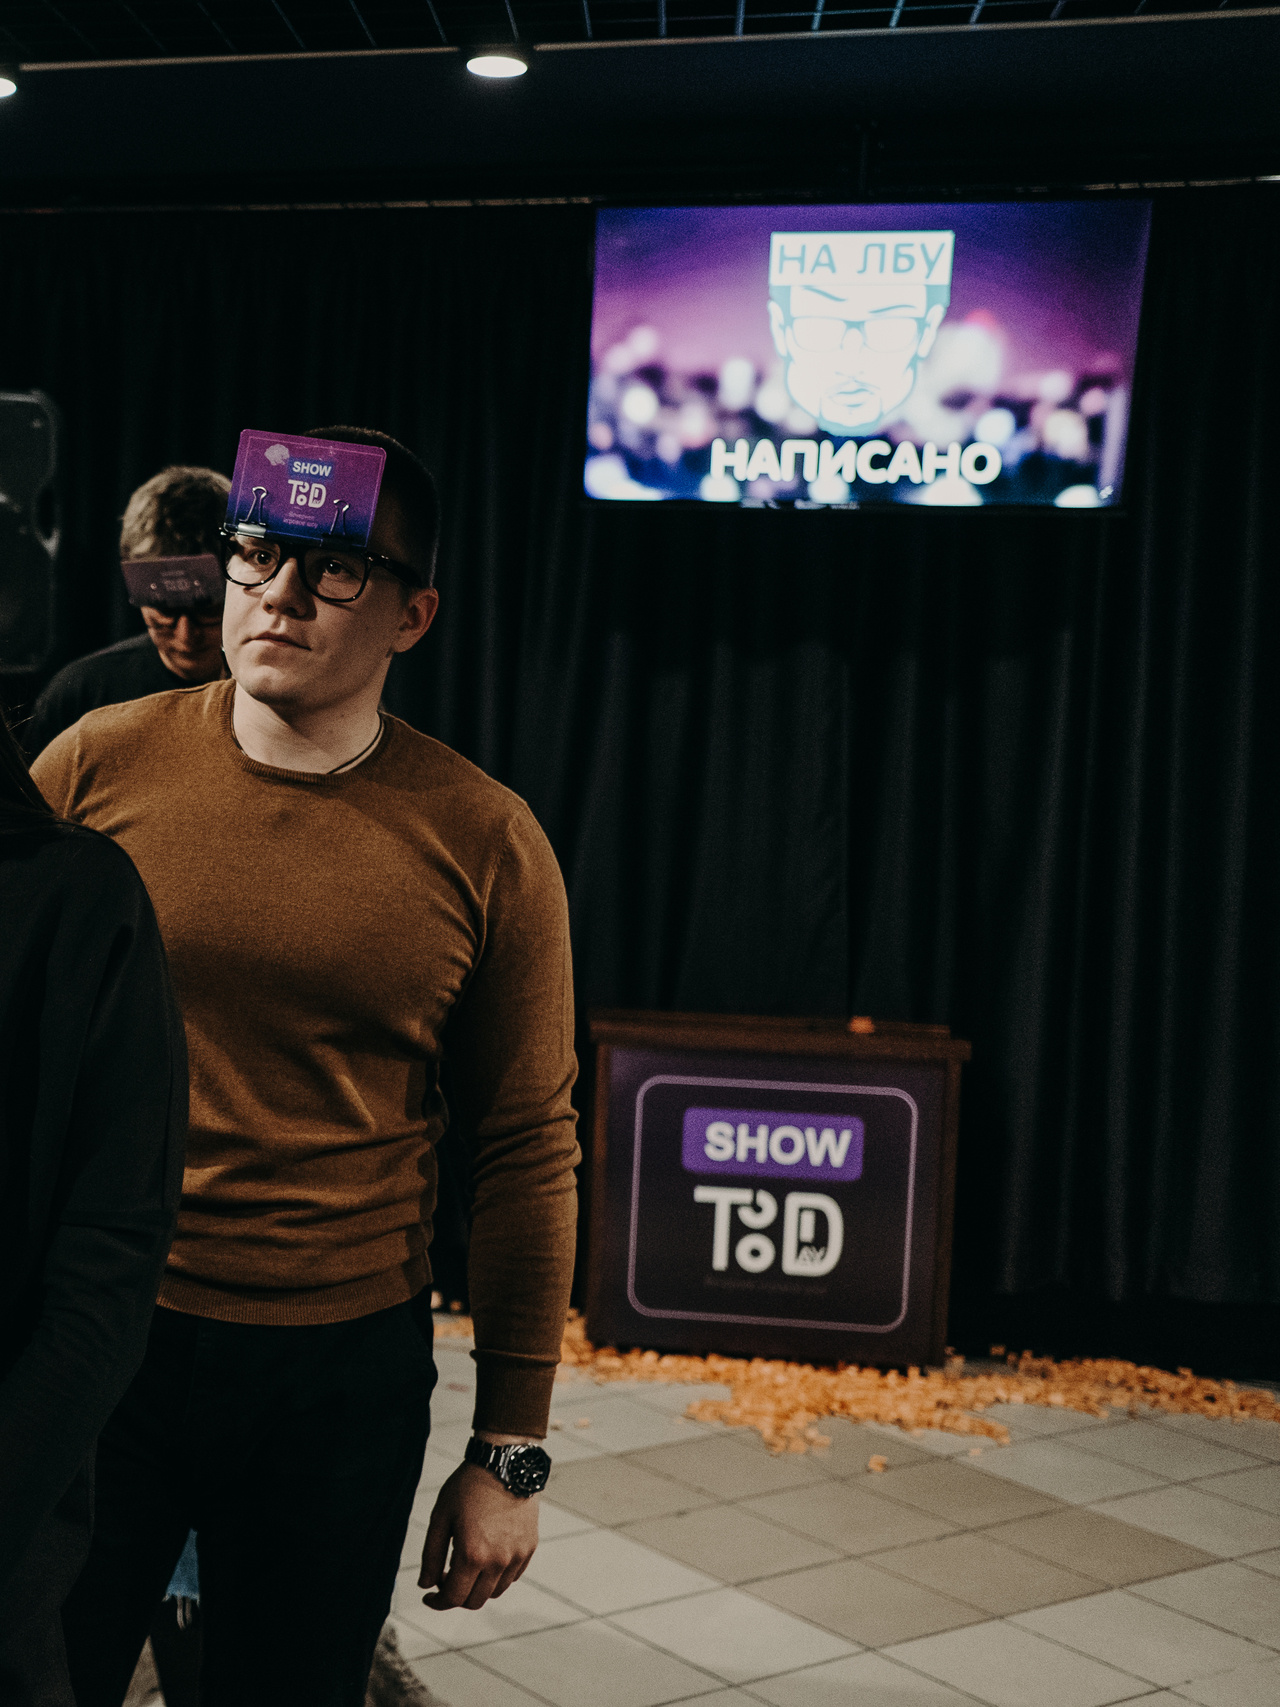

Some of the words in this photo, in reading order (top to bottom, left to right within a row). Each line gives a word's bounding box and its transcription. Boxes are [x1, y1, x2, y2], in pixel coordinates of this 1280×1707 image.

[778, 243, 837, 274] НА
[856, 242, 945, 279] ЛБУ
[292, 461, 332, 476] SHOW
[710, 438, 1002, 485] НАПИСАНО
[704, 1121, 852, 1168] SHOW
